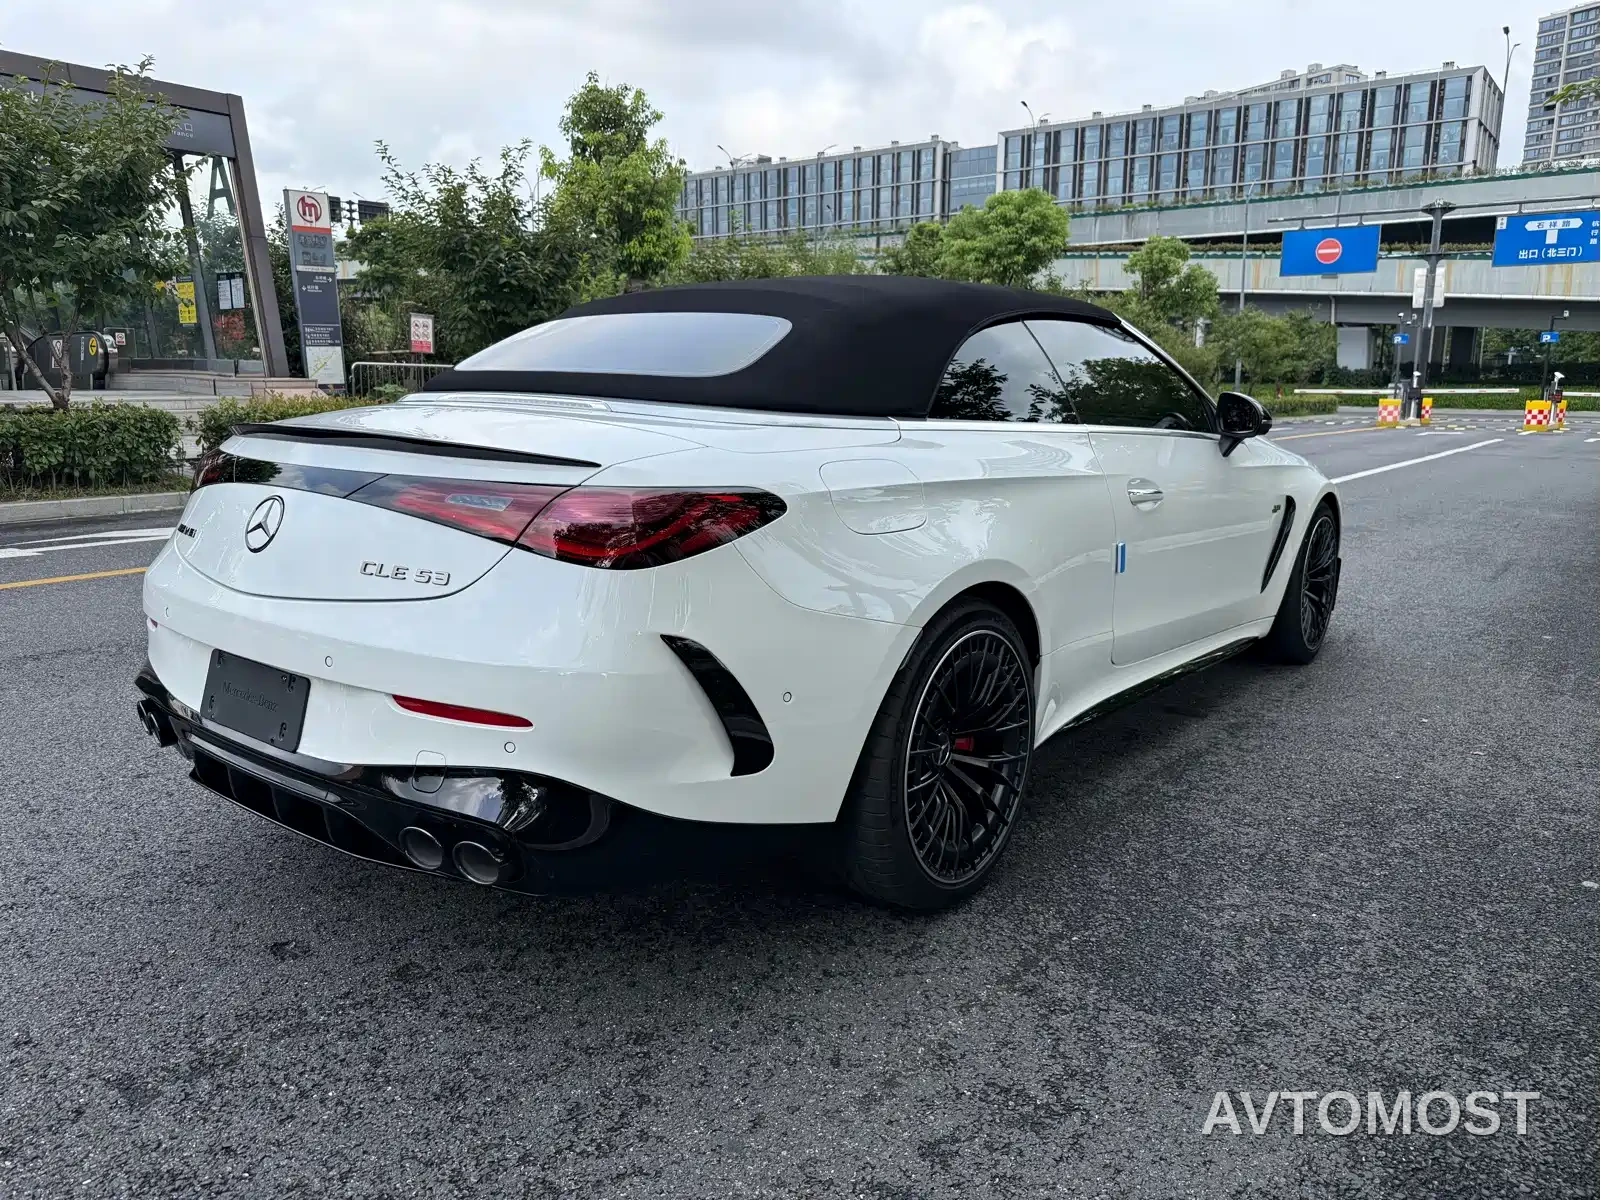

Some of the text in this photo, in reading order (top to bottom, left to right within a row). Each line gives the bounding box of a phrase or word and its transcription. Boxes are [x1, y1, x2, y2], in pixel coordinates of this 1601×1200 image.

[208, 156, 236, 219] A
[360, 560, 451, 586] CLE 53
